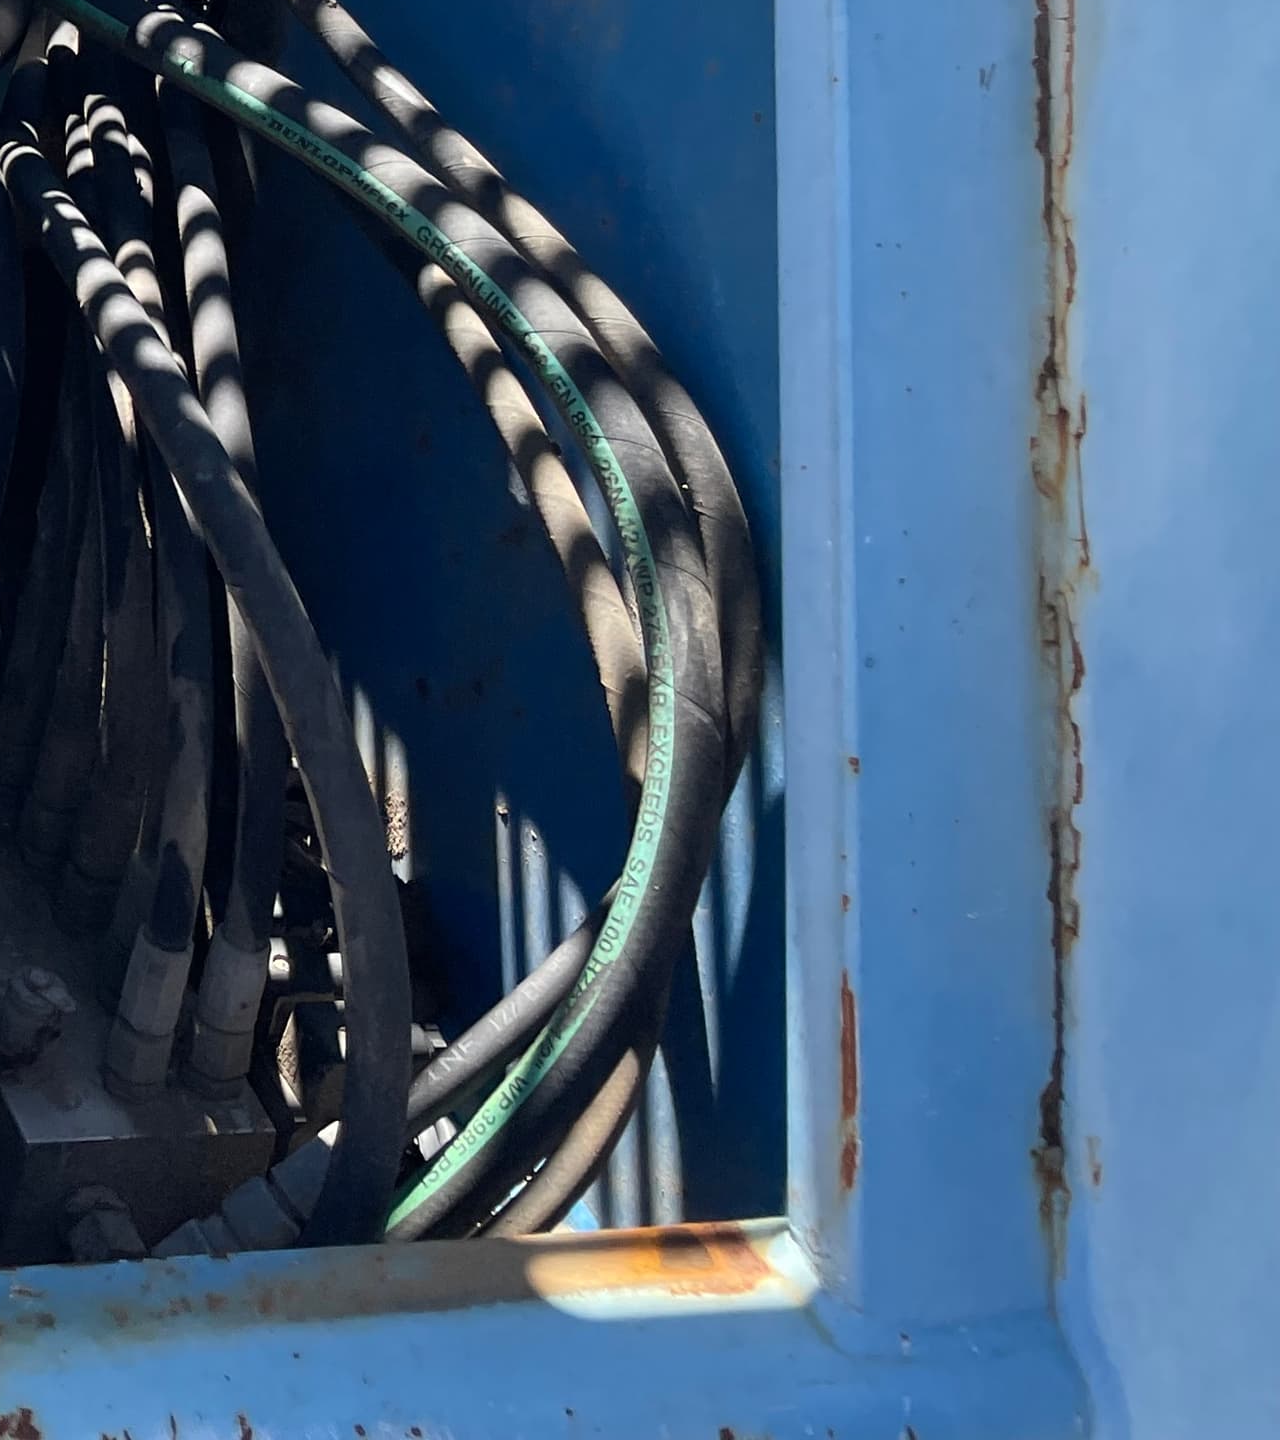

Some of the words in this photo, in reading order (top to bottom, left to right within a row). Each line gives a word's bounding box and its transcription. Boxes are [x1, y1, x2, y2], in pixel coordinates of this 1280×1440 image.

[268, 118, 353, 179] DUNLOP
[351, 171, 410, 222] HIFLEX
[416, 224, 517, 324] GREENLINE
[550, 375, 577, 406] EN
[636, 558, 655, 598] WP
[637, 724, 668, 843] EXCEEDS
[616, 859, 646, 906] SAE
[598, 916, 622, 953] 100
[498, 1075, 529, 1112] WP
[453, 1109, 497, 1156] 3985
[421, 1151, 452, 1189] PSI
